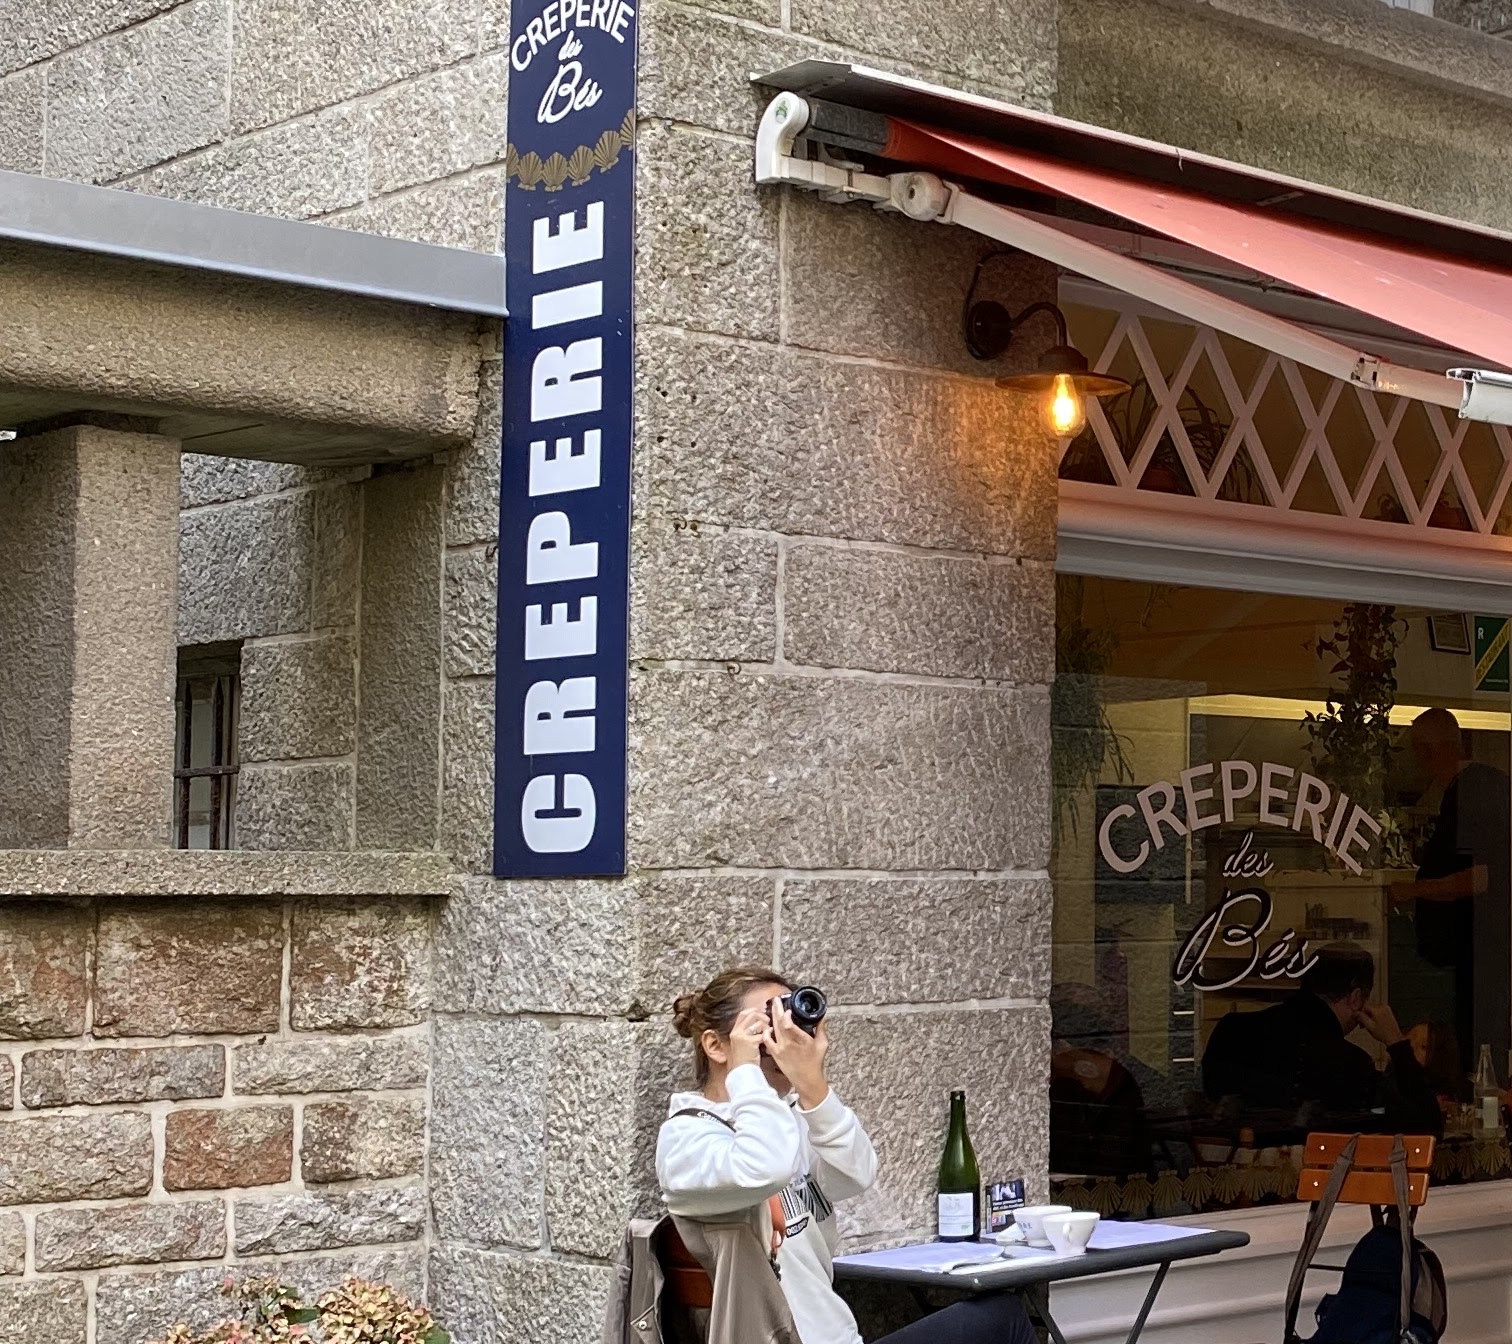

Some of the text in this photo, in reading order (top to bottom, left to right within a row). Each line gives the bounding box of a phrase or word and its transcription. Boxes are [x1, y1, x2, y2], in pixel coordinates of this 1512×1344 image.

[521, 200, 605, 855] CREPERIE
[1098, 760, 1382, 876] CREPERIE
[1222, 828, 1275, 878] des
[1172, 886, 1320, 992] Bés
